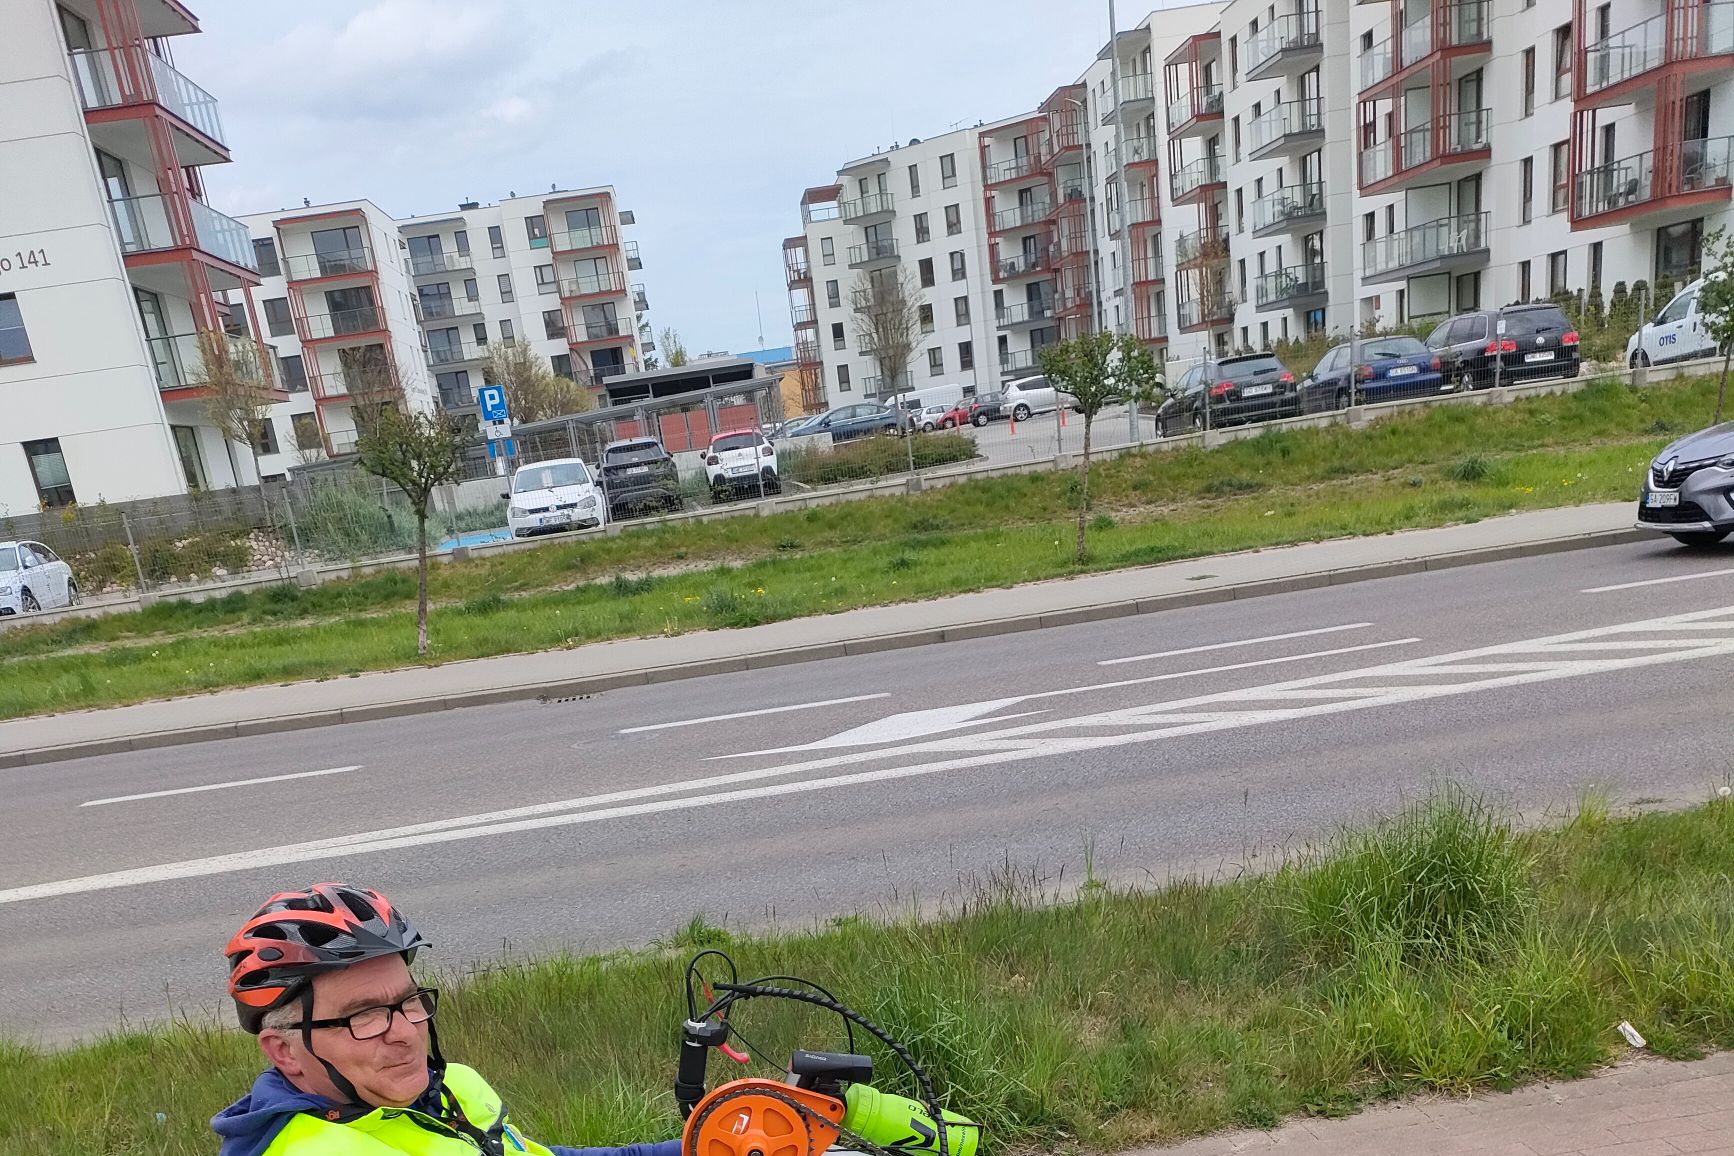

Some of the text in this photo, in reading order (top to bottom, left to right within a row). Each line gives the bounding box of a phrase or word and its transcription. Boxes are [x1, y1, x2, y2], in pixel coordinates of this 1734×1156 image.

[15, 249, 51, 270] 141
[1658, 333, 1677, 347] OTIS
[484, 389, 500, 411] P
